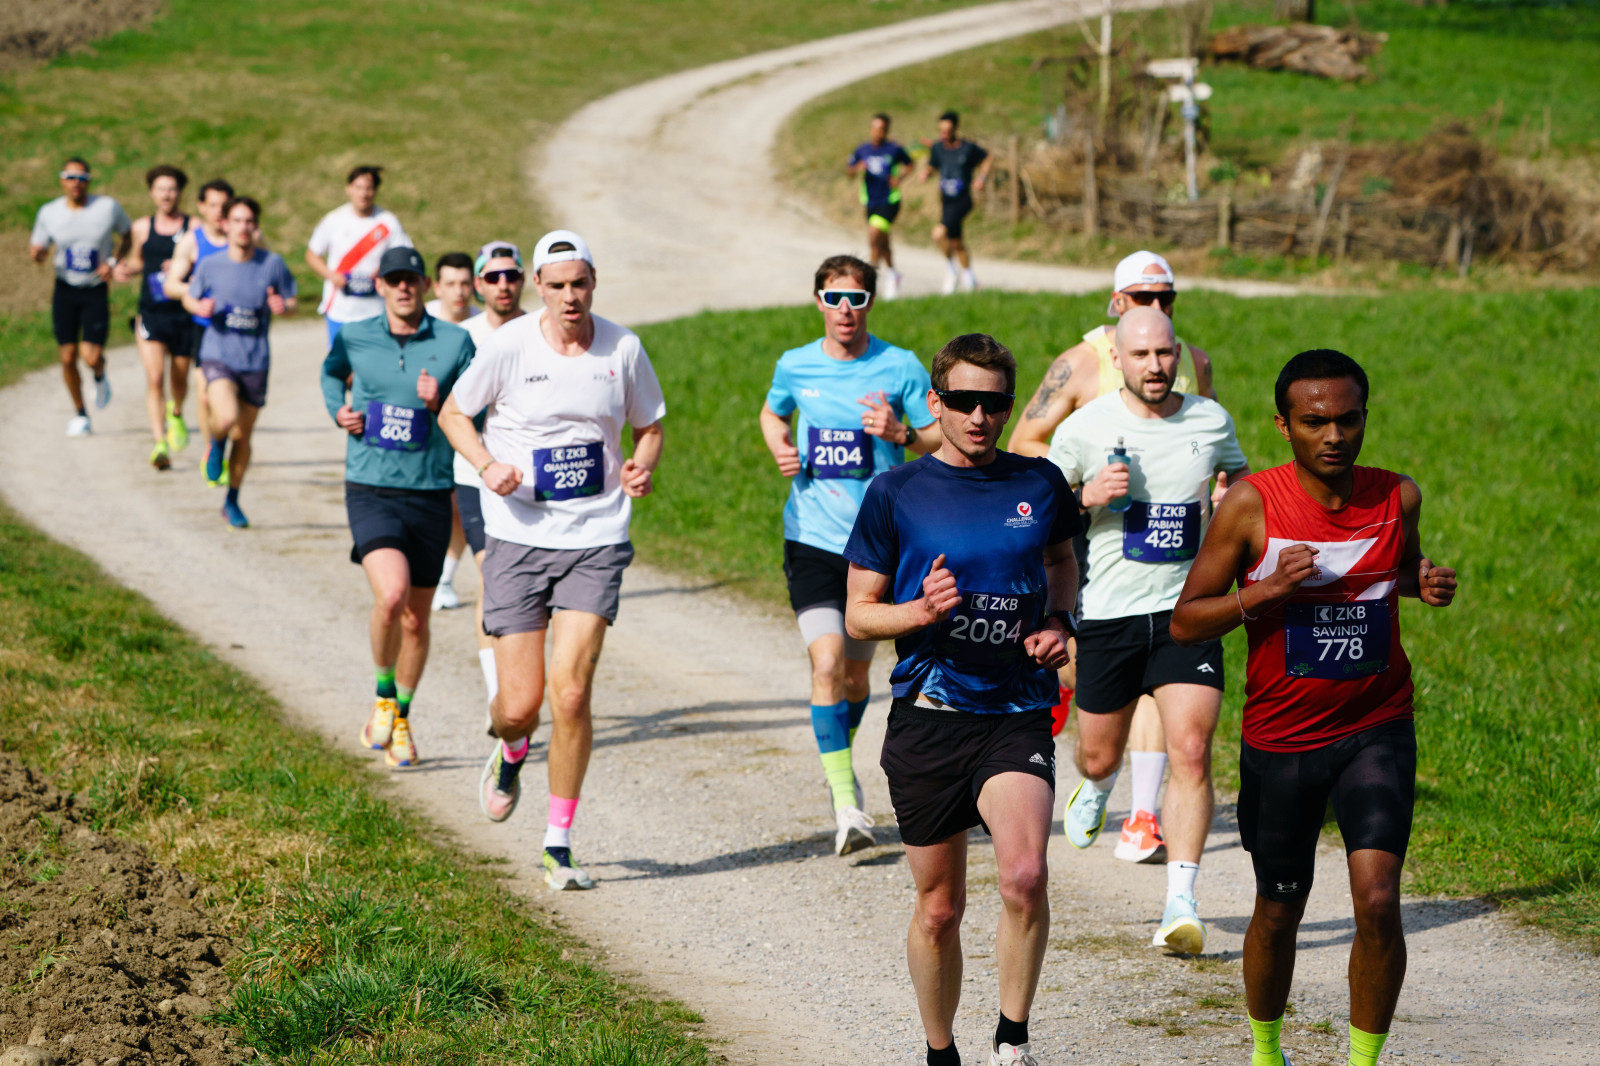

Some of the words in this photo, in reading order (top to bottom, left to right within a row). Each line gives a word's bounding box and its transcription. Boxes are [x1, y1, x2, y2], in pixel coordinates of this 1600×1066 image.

[380, 424, 412, 442] 606
[832, 430, 855, 442] ZKB
[566, 443, 587, 459] ZKB
[814, 445, 863, 466] 2104
[554, 468, 587, 489] 239
[1162, 505, 1187, 518] ZKB
[1148, 519, 1184, 529] FABIAN
[1144, 529, 1184, 548] 425
[989, 597, 1019, 611] ZKB
[1335, 605, 1366, 621] ZKB
[949, 614, 1022, 645] 2084
[1312, 624, 1368, 637] SAVINDU
[1317, 637, 1364, 661] 778
